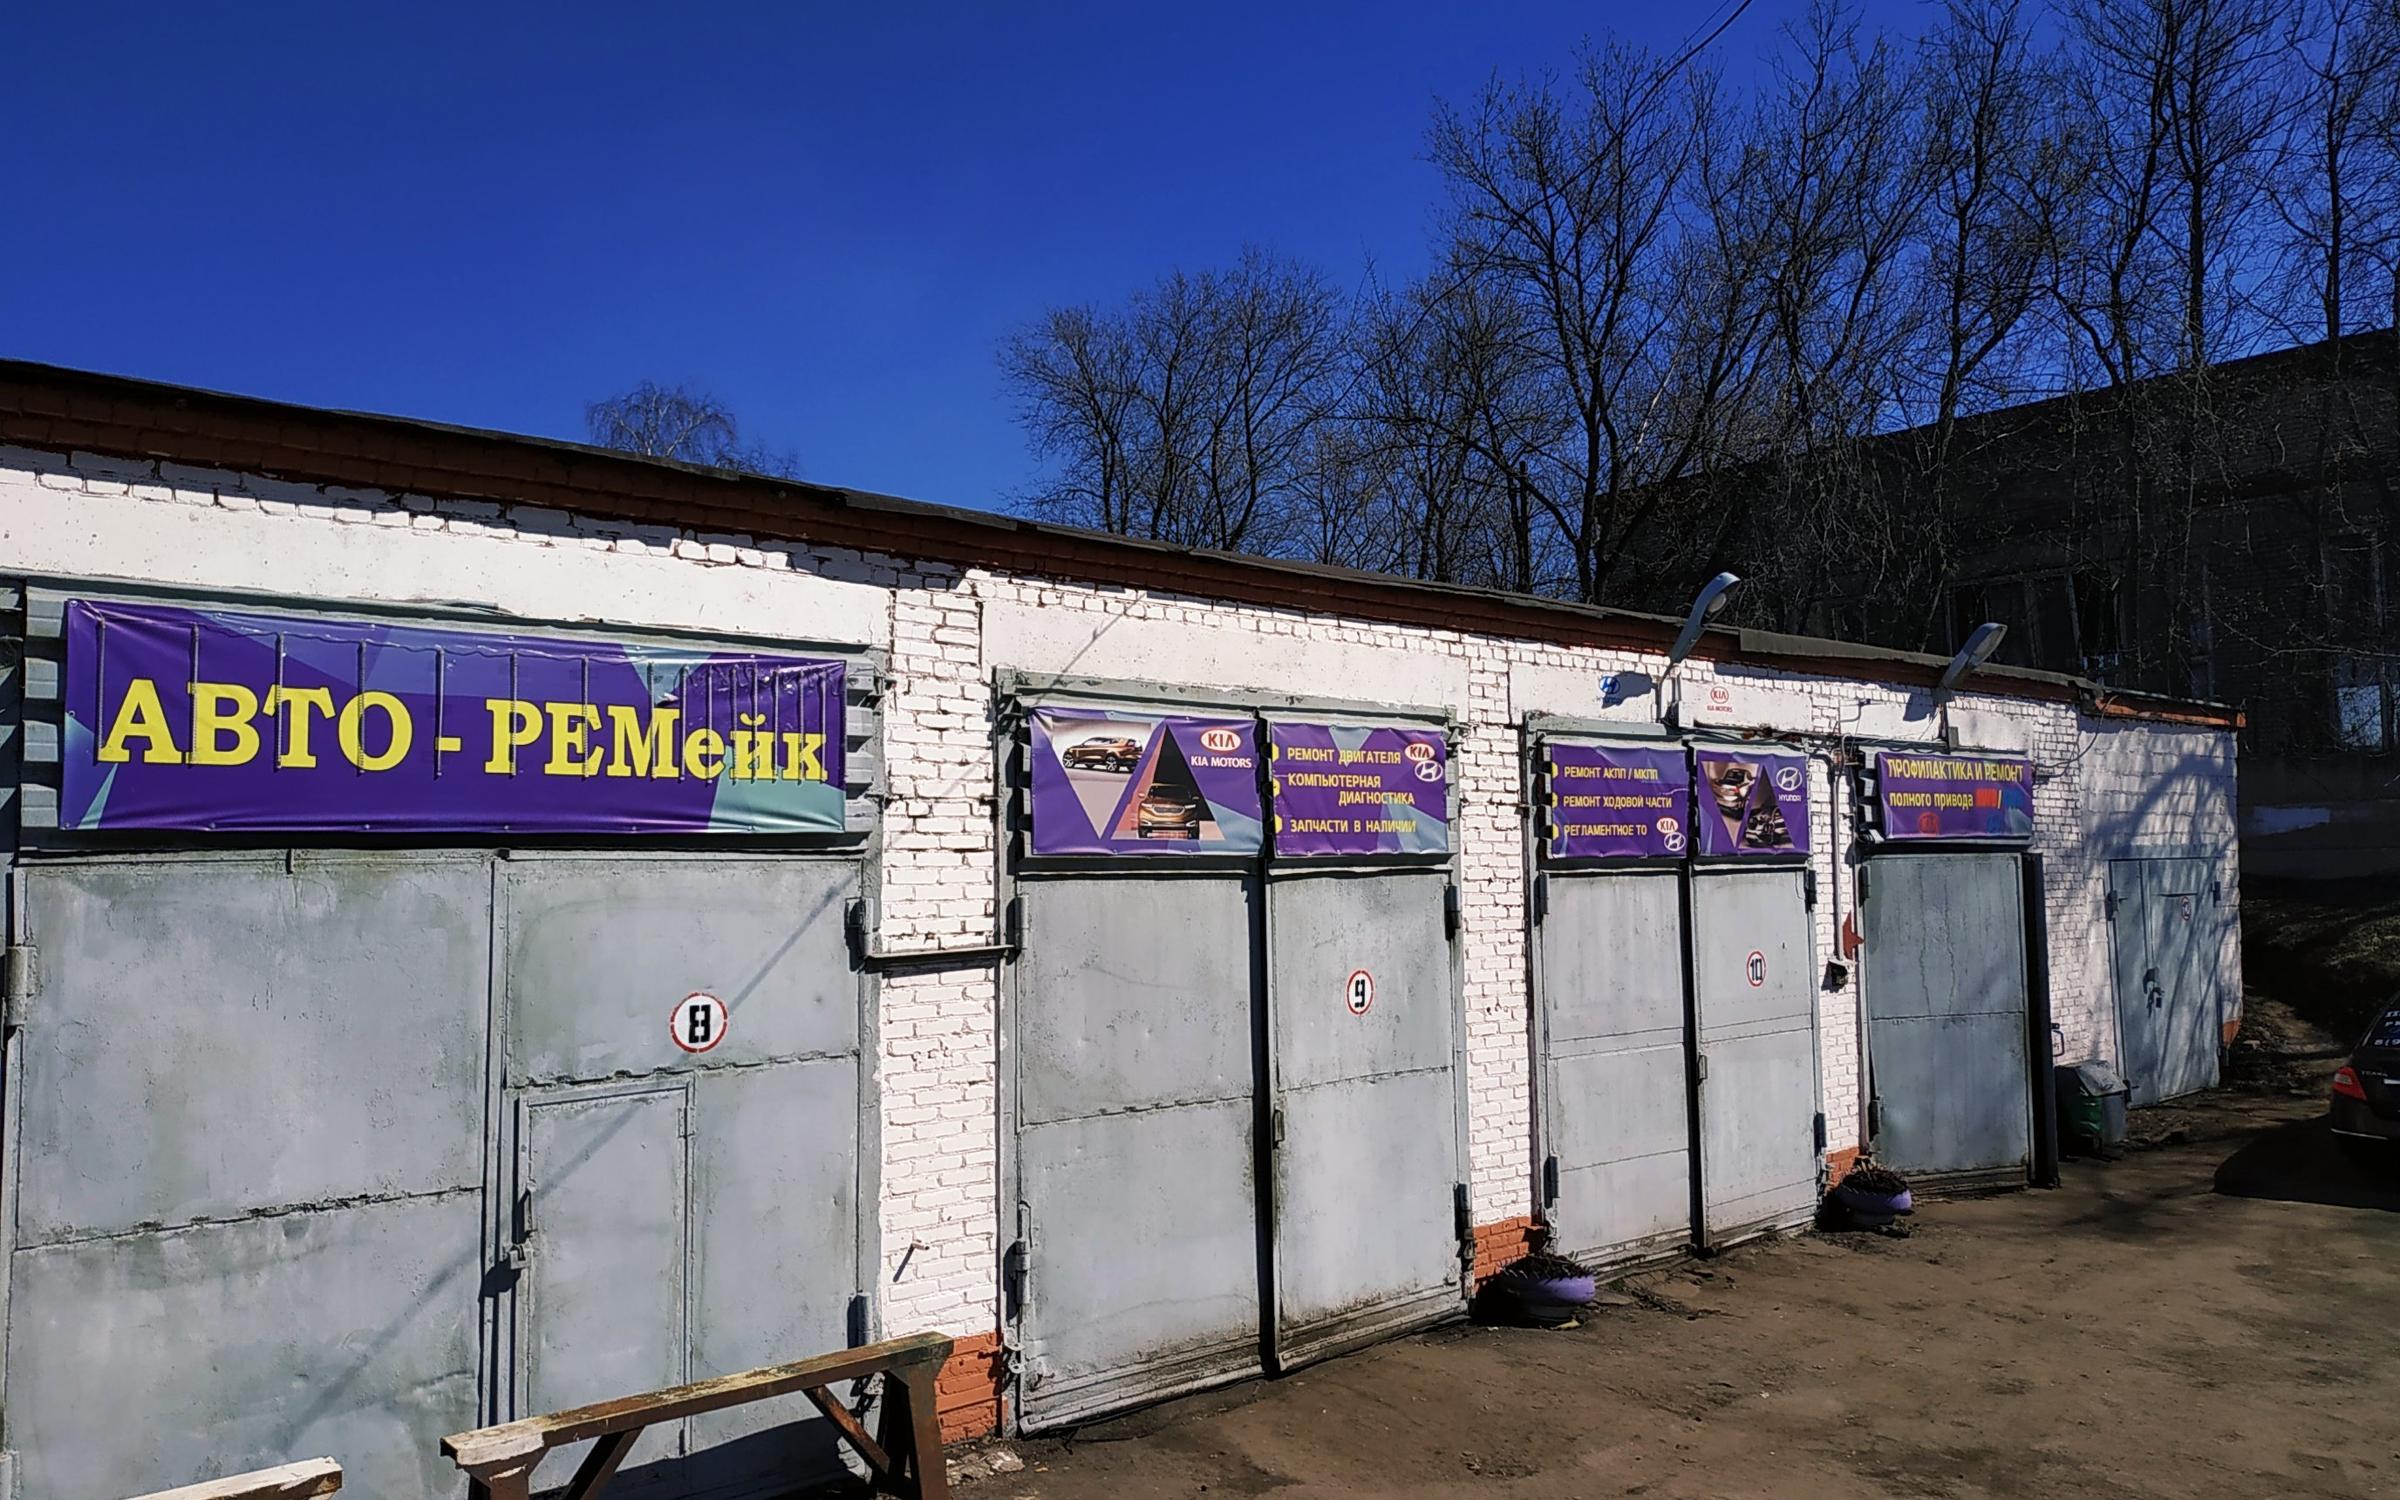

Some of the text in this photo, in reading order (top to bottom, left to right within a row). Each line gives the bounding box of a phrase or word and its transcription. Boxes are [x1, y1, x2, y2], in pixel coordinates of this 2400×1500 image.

[1713, 690, 1727, 699] KIA
[97, 678, 829, 780] АВТО - РЕМейк
[1207, 733, 1236, 748] KIA
[1287, 747, 1401, 765] РЕМОНТ ДВИГАТЕЛЯ
[1410, 746, 1430, 758] KIA
[1191, 756, 1252, 768] KIA MOTORS
[1564, 766, 1601, 778] РЕМОНТ
[1603, 767, 1626, 779] АКПП
[1633, 768, 1659, 780] МКПП
[1888, 759, 2024, 782] ПРОФИЛАКТИКА И РЕМОНТ
[1288, 773, 1381, 787] КОМПЬЮТЕРНАЯ
[1338, 791, 1416, 806] ДИАГНОСТИКА
[1563, 795, 1672, 810] РЕМОНТ ХОДОВОЙ ЧАСТИ
[1889, 792, 1932, 807] полного
[1934, 793, 1974, 811] привода
[1290, 819, 1417, 832] ЗАПЧАСТИ В НАЛИЧИИ
[1564, 825, 1648, 836] РЕГЛАМЕНТНОЕ ТО
[1659, 820, 1676, 831] KIA
[1750, 958, 1763, 981] 10
[1354, 979, 1366, 1008] 9
[688, 1004, 711, 1044] 8
